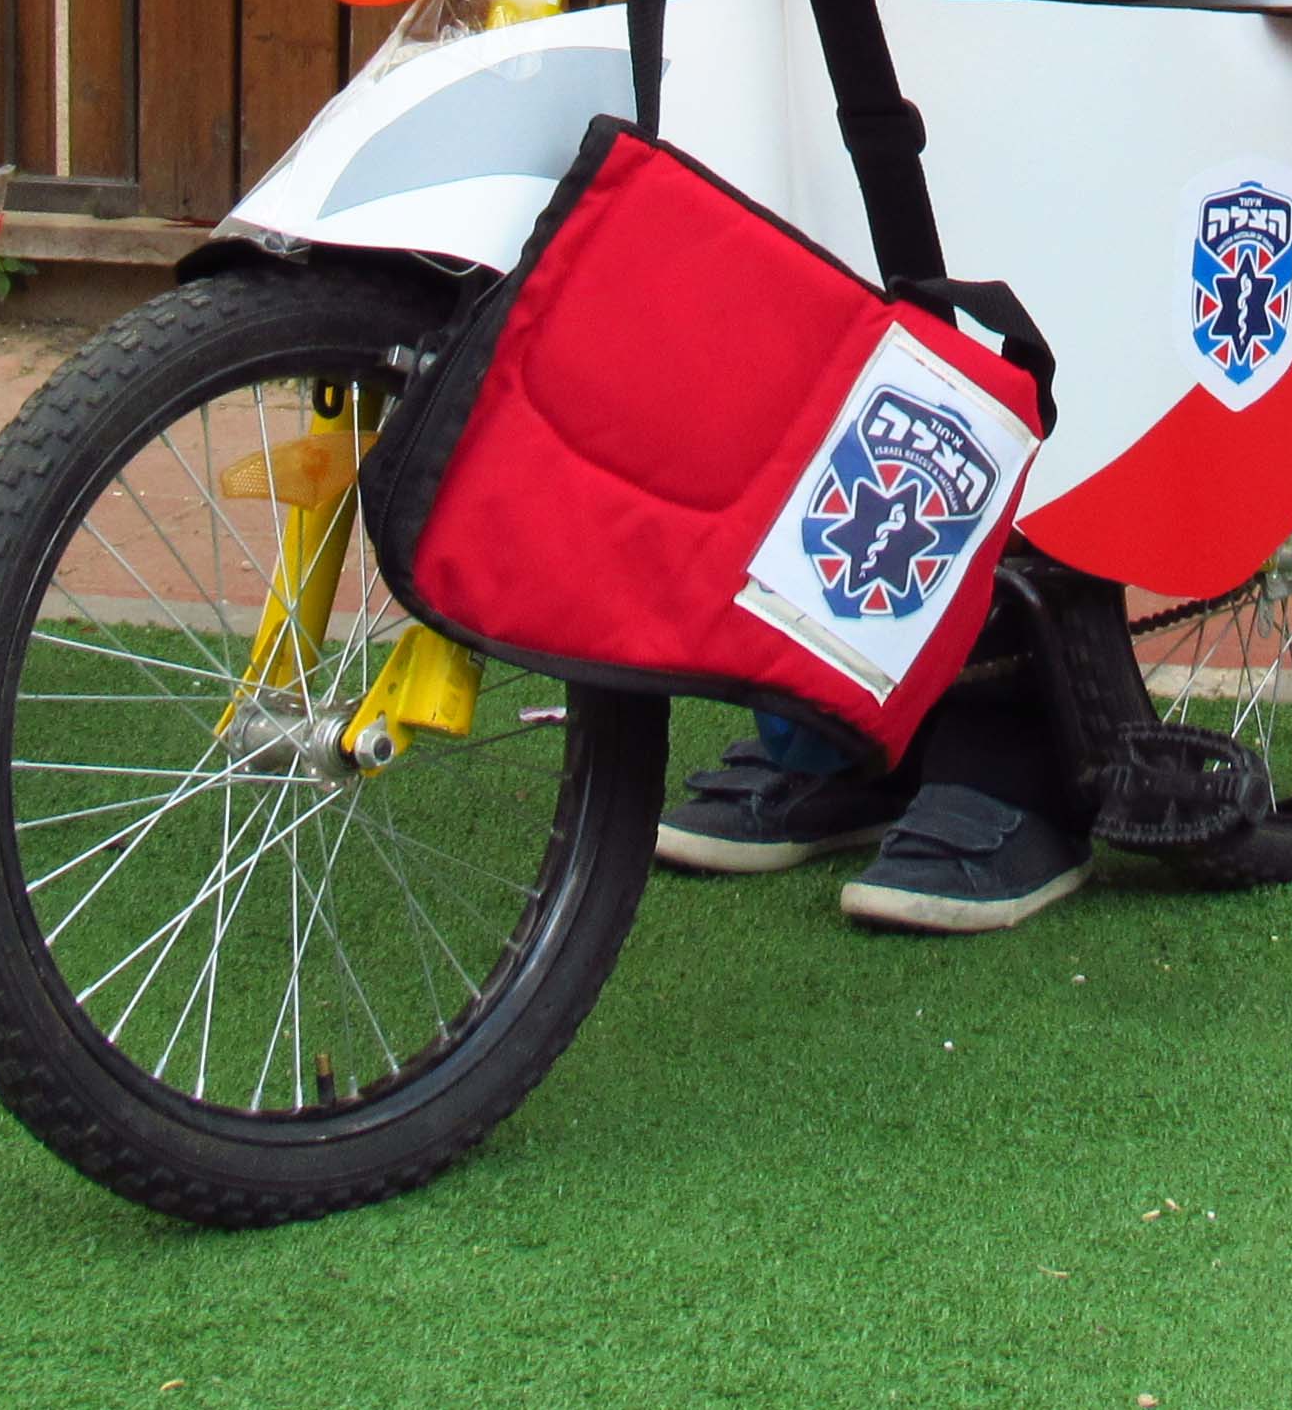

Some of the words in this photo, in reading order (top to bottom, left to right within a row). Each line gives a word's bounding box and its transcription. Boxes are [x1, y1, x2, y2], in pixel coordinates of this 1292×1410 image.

[1206, 205, 1287, 244] הצלה
[930, 417, 965, 449] איחוד
[867, 400, 988, 511] הצלה
